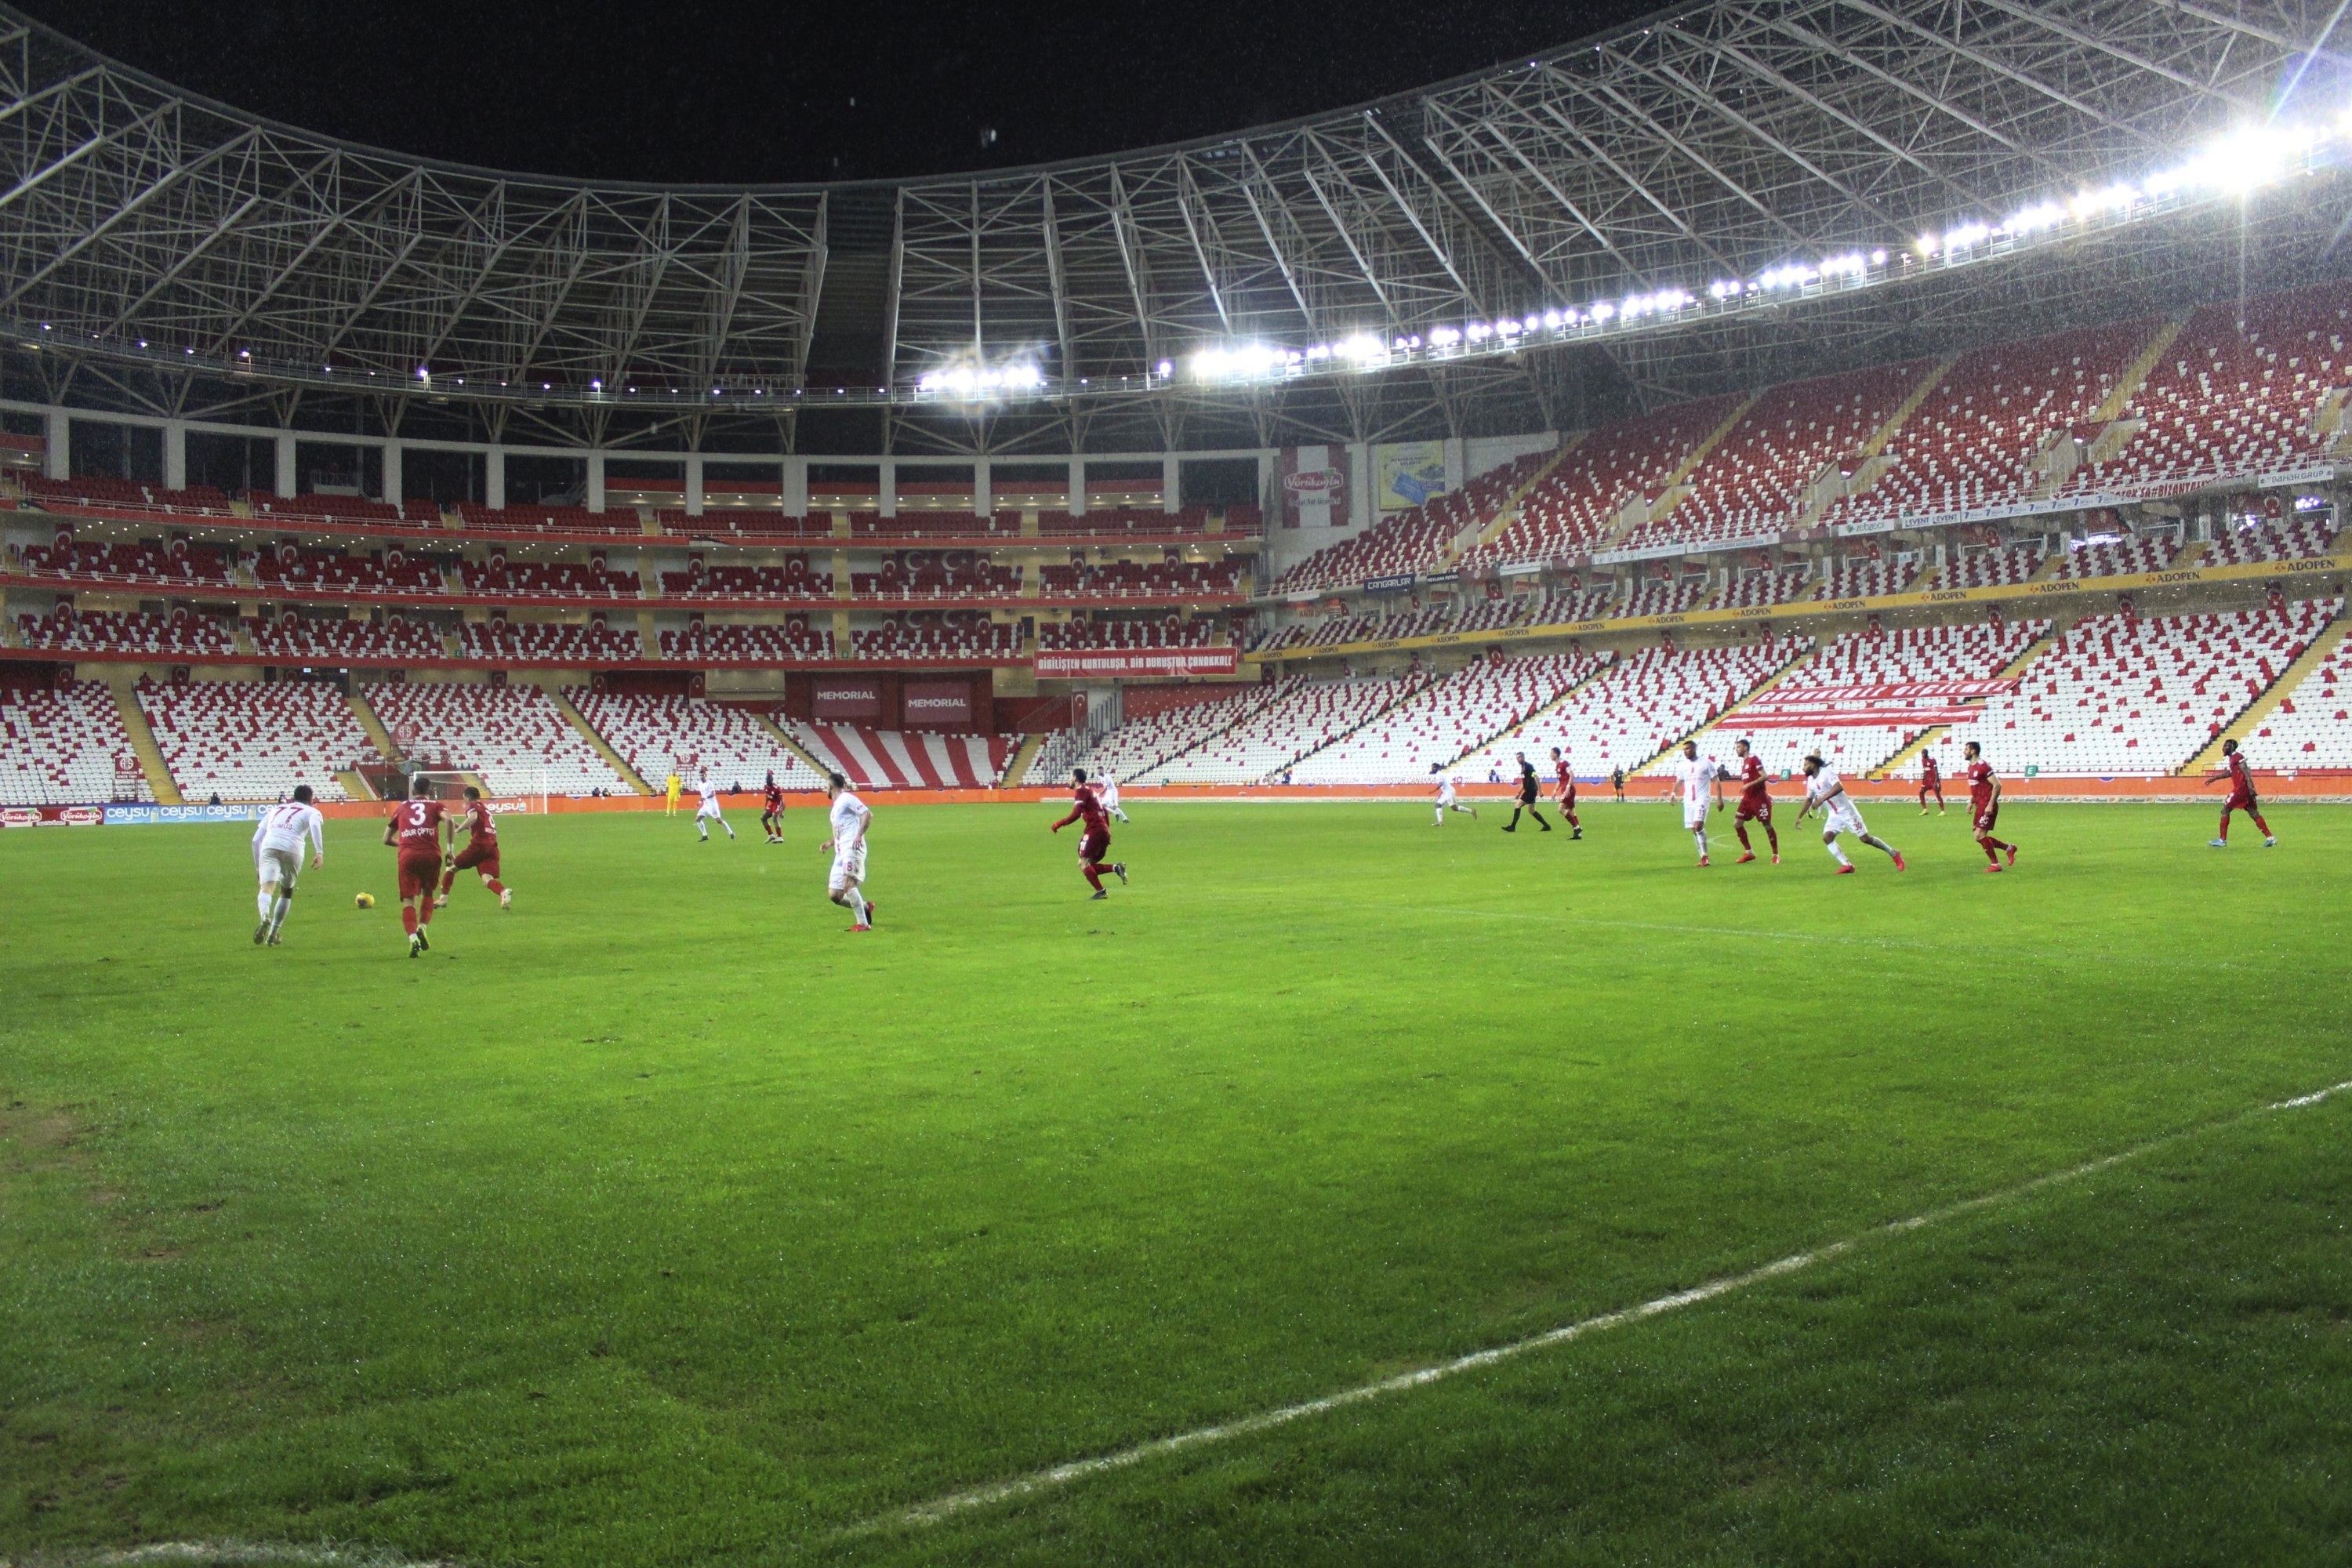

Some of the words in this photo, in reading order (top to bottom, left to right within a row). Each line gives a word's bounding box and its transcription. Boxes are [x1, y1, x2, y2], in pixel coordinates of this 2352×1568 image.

[2288, 560, 2336, 572] ADOPEN
[2157, 572, 2200, 583] ADOPEN
[2040, 582, 2079, 593] ADOPEN
[1930, 591, 1967, 601] ADOPEN
[1832, 601, 1866, 610] ADOPEN
[1740, 608, 1771, 617] ADOPEN
[1577, 623, 1605, 632] ADOPEN
[1504, 629, 1529, 637] ADOPEN
[1436, 635, 1460, 644] ADOPEN
[1188, 655, 1232, 670] ÇANAKKALE
[817, 691, 876, 700] MEMORIAL
[908, 698, 967, 707] MEMORIAL
[107, 806, 150, 820] ceysu
[161, 805, 202, 819] ceysu
[206, 804, 248, 819] ceysu
[484, 803, 519, 813] eysu
[1759, 808, 1769, 817] 25
[2, 812, 40, 822] Yörükoğlu
[63, 811, 100, 822] Yörükoğlu
[270, 806, 304, 824] 77
[408, 803, 426, 826] 3
[1853, 822, 1863, 831] 30
[401, 828, 416, 837] UĞUR
